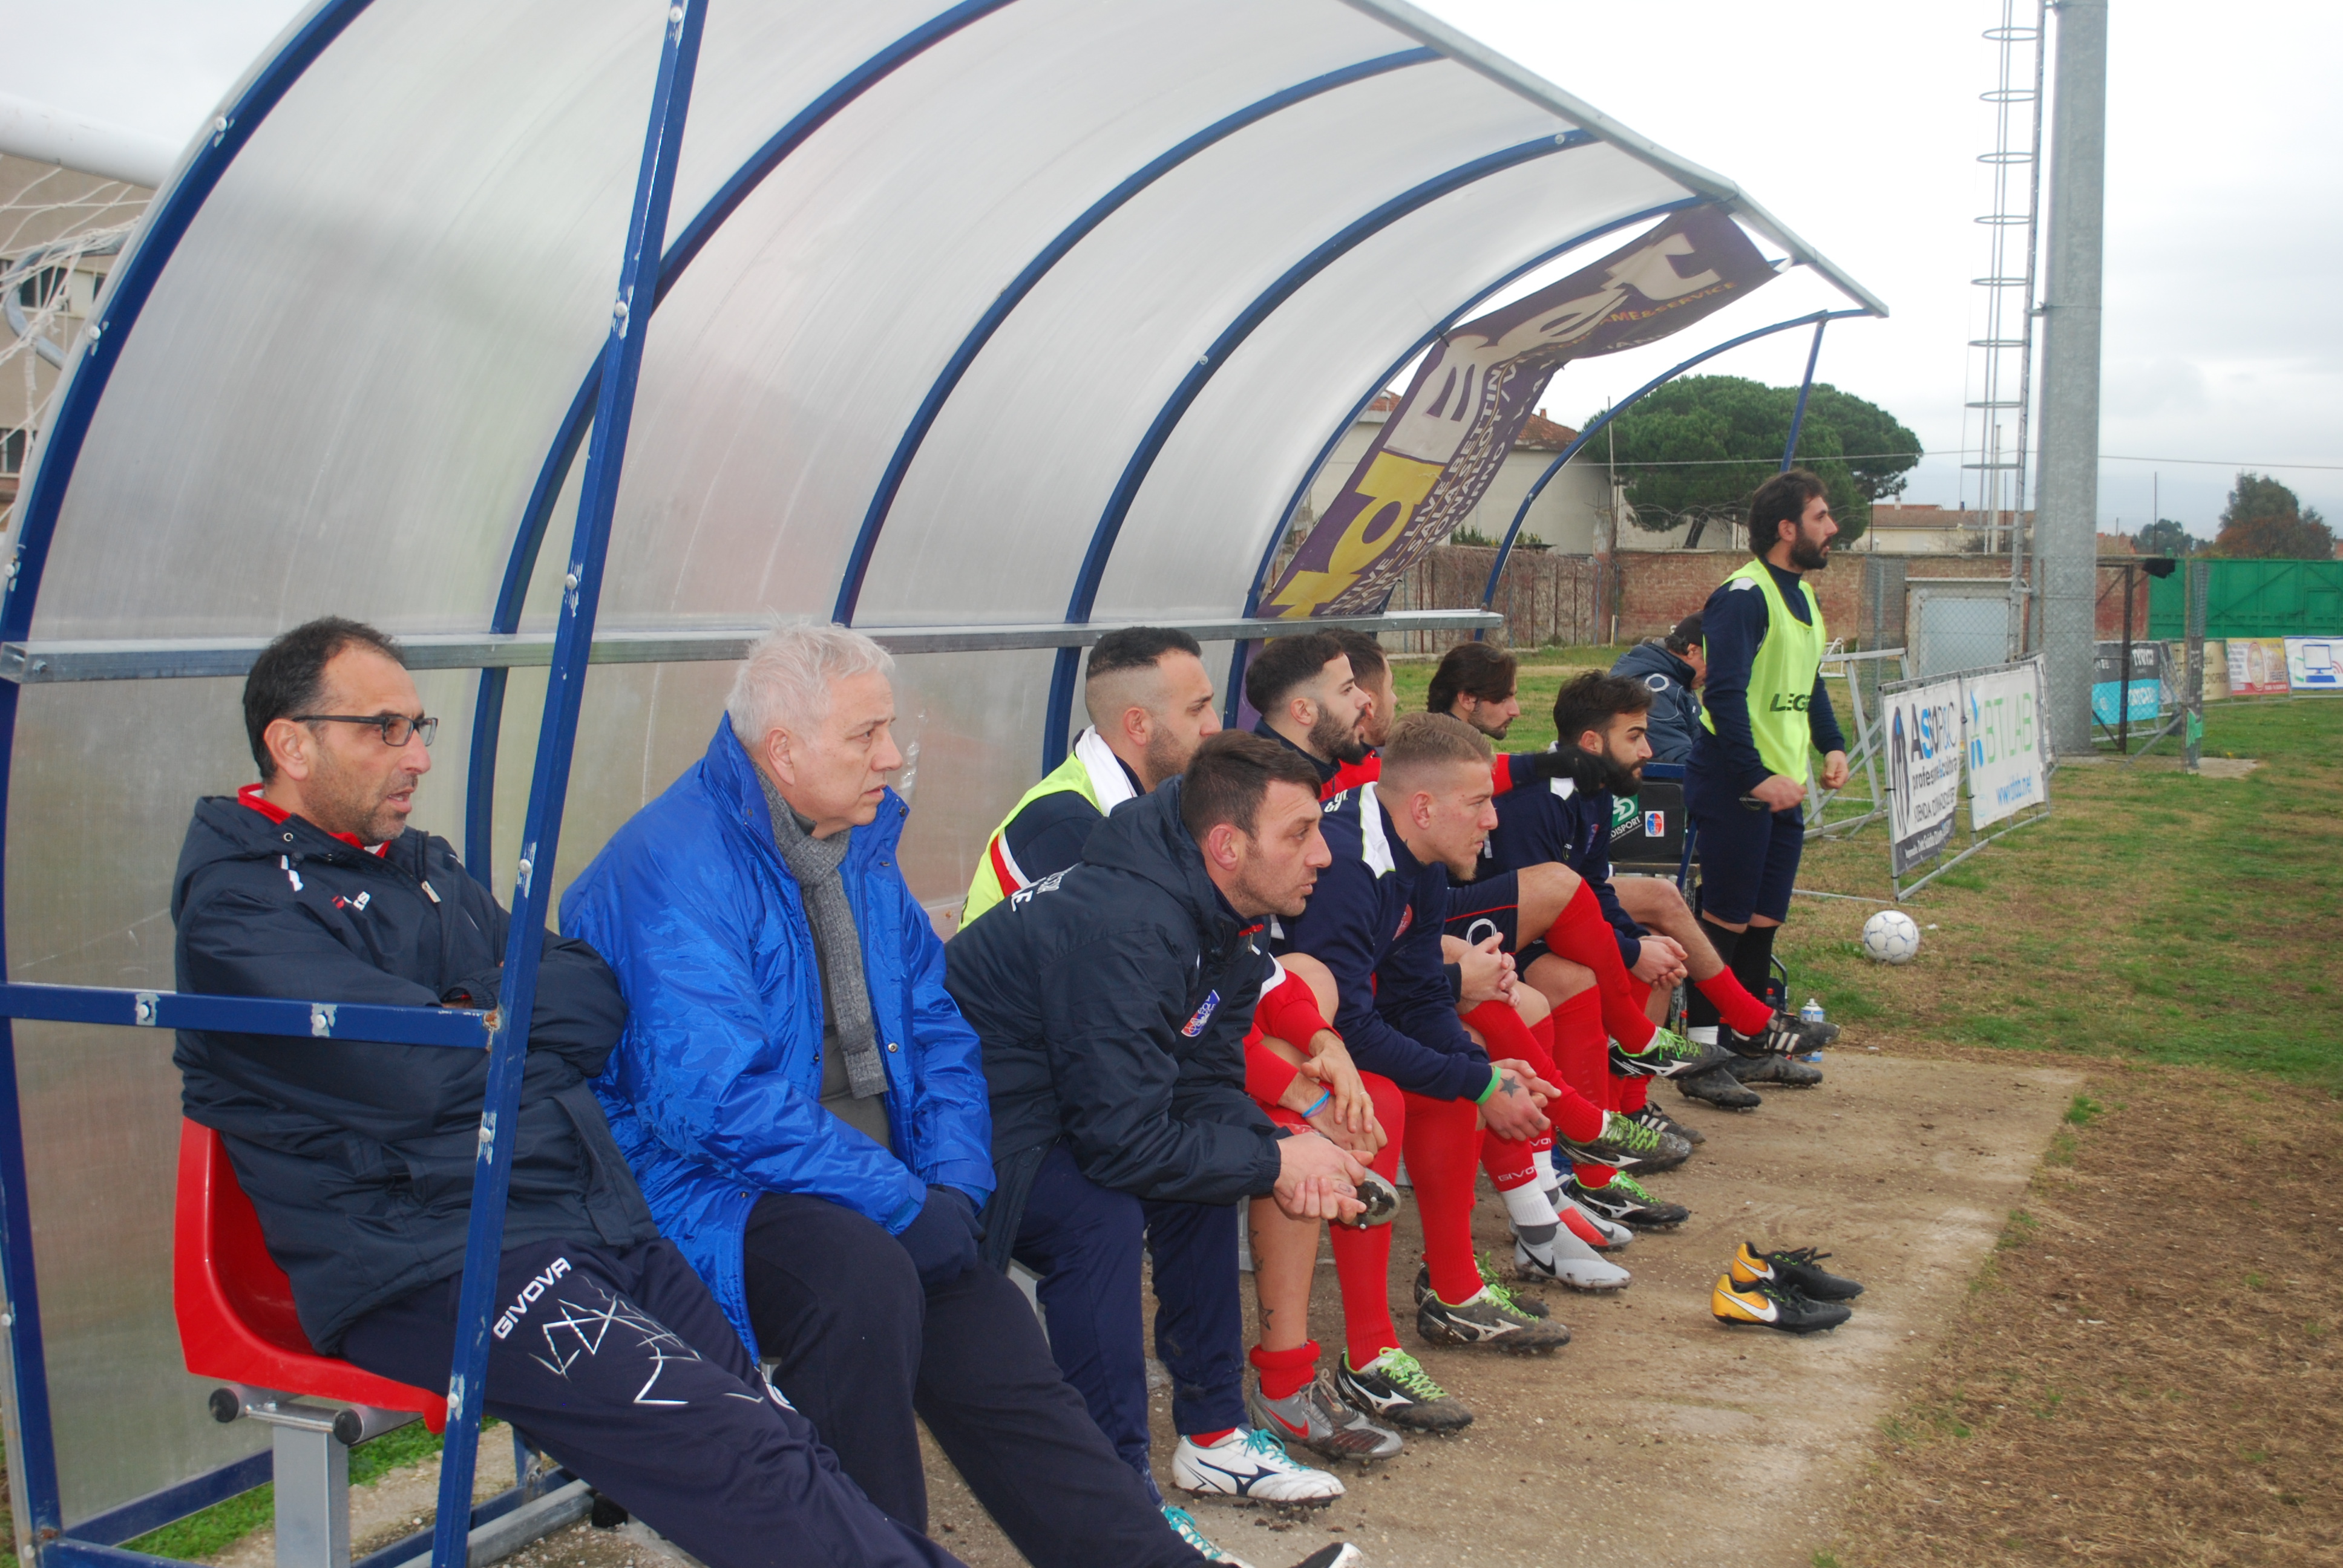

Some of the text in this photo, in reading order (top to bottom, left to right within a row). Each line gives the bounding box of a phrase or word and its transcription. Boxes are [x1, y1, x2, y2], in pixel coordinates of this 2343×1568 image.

[1404, 481, 1450, 538] LIVE
[1407, 486, 1459, 552] SALA
[1459, 410, 1502, 477] SLOT
[493, 1257, 571, 1339] GIVOVA
